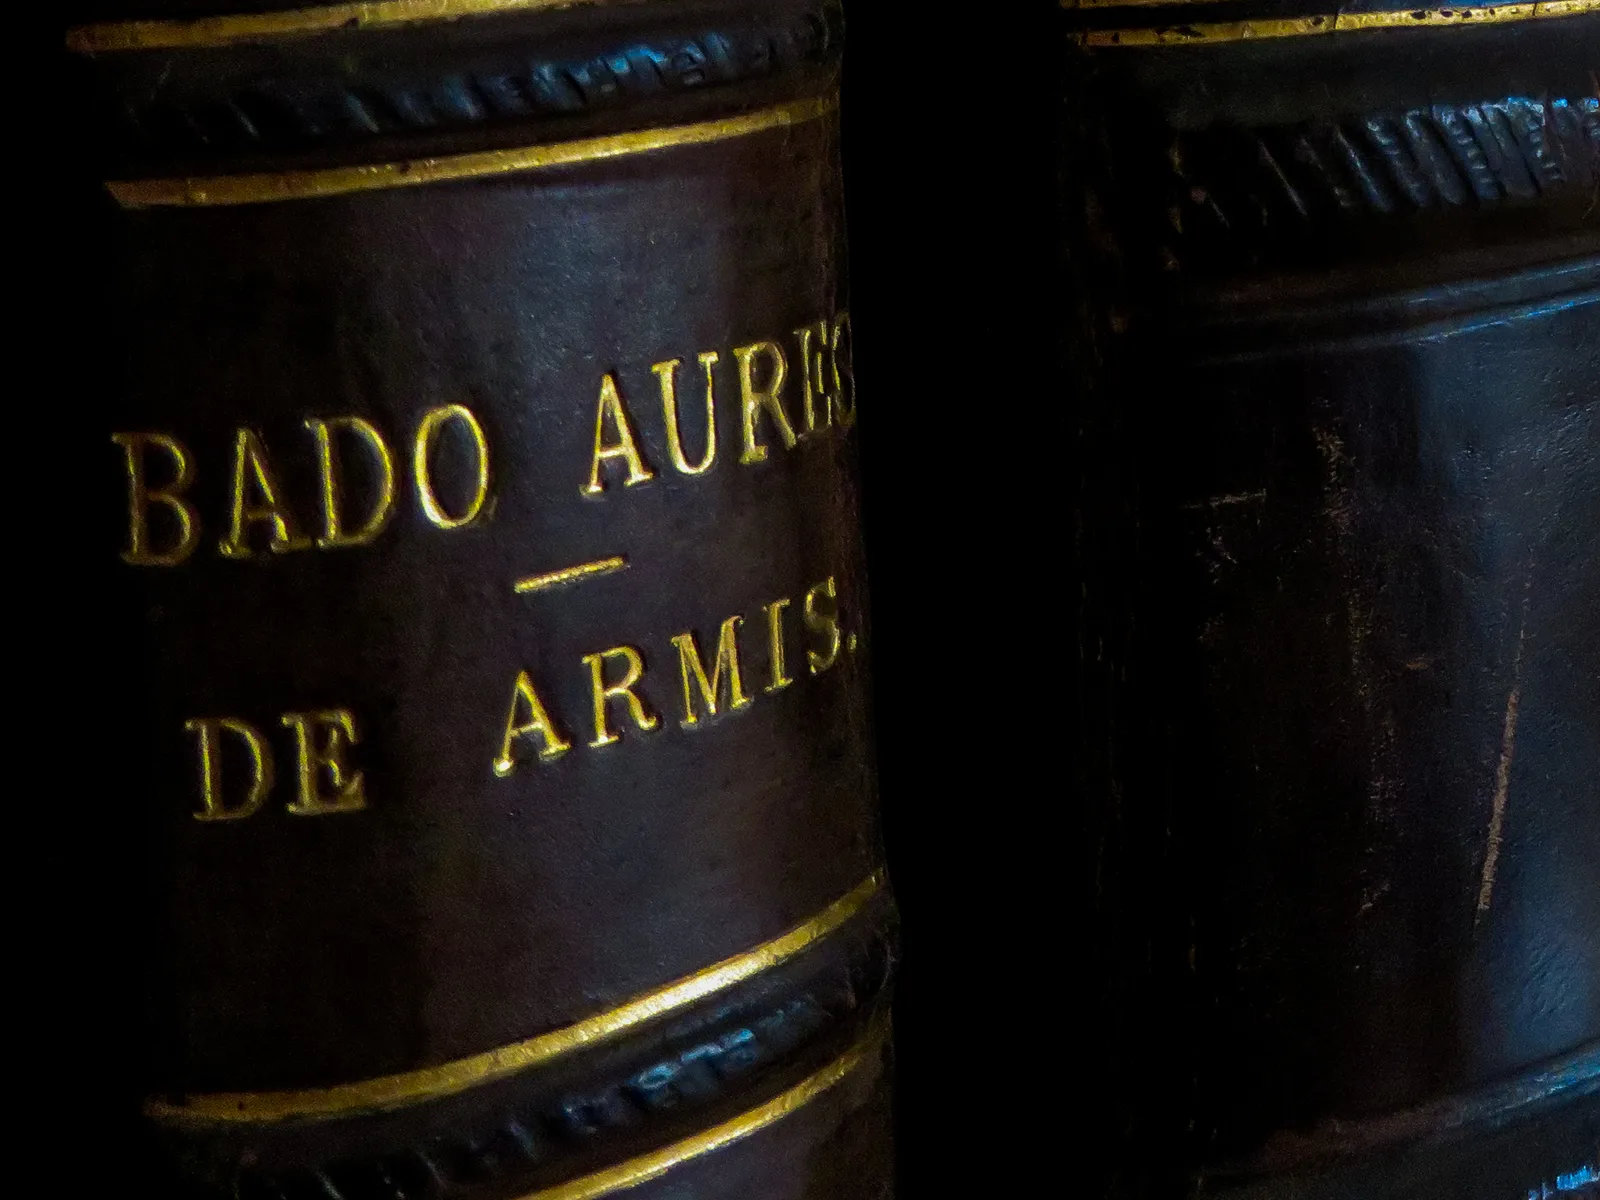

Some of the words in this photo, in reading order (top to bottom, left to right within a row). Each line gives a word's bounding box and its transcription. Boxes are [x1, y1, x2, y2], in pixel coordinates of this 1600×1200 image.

[111, 402, 491, 567] BADO
[183, 708, 367, 821] DE
[491, 576, 858, 777] ARMIS.
